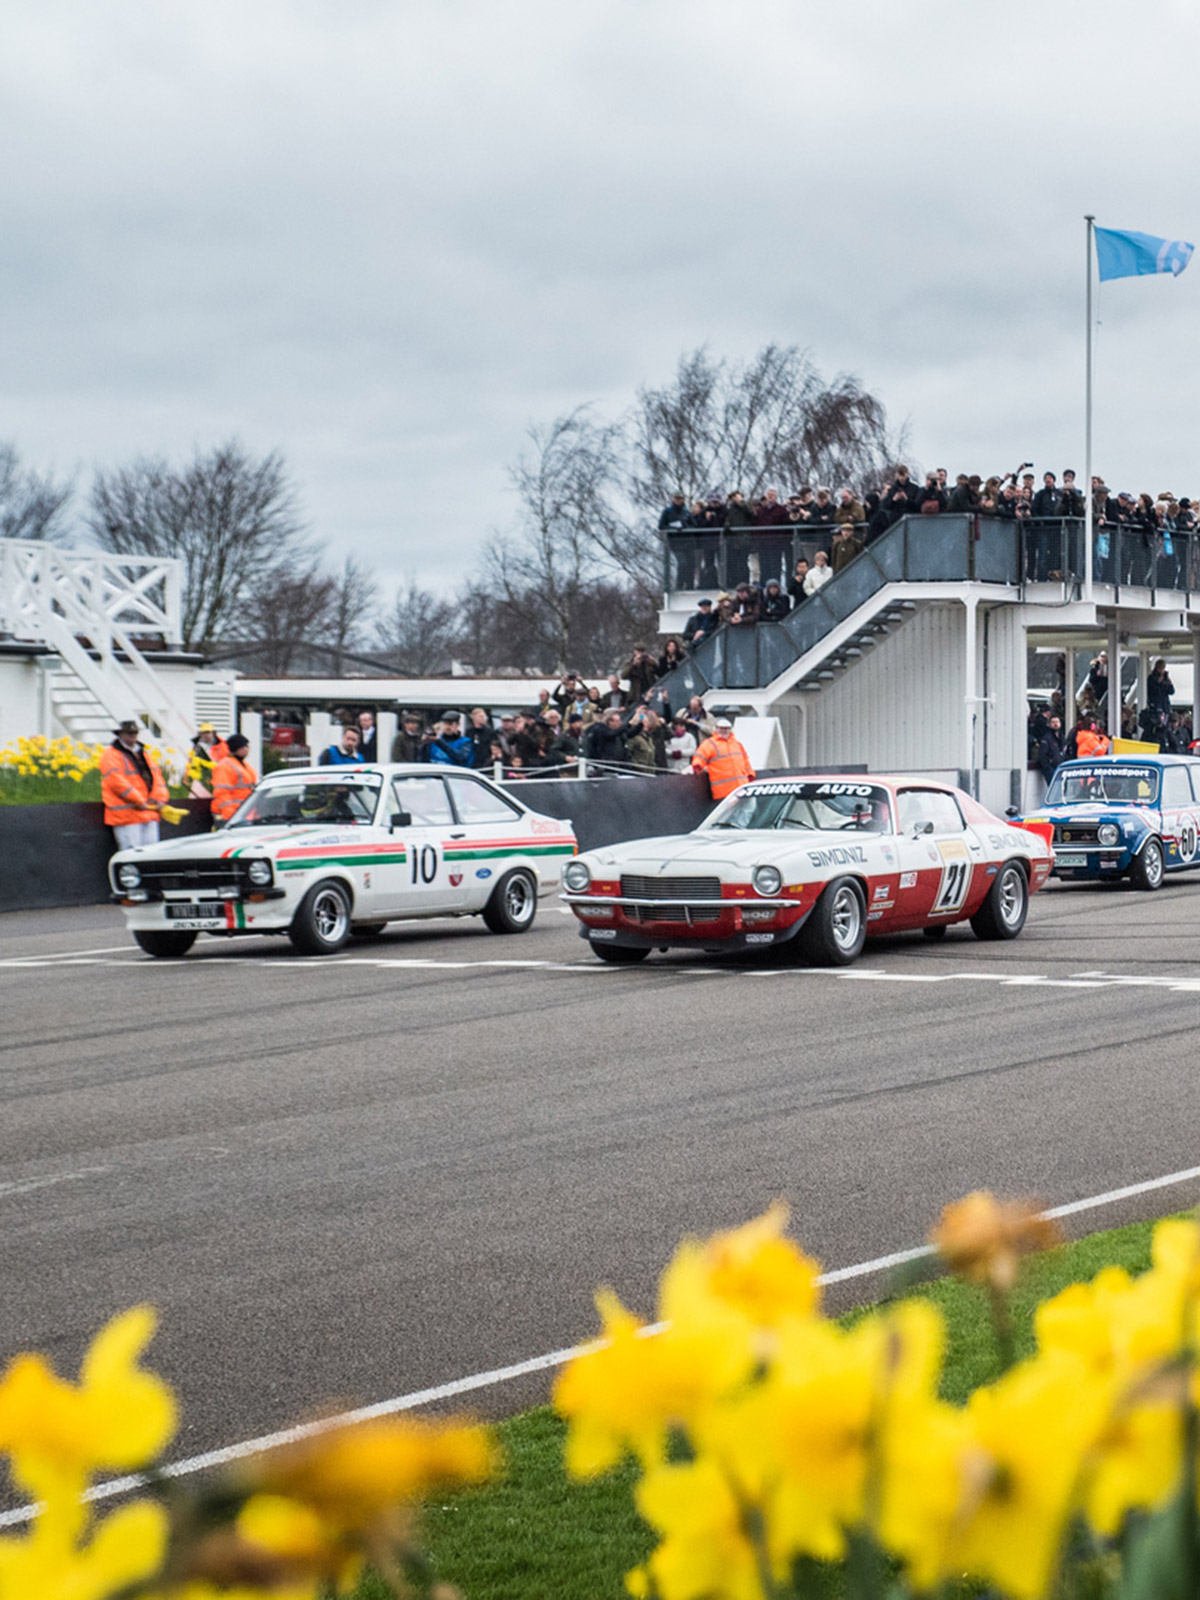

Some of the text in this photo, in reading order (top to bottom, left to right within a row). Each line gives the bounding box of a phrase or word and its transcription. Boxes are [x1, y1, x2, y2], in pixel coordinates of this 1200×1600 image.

[1179, 613, 1184, 627] 1
[746, 784, 873, 796] THINK AUTO
[1181, 827, 1195, 856] 60
[411, 844, 437, 884] 10
[807, 845, 868, 868] SIMONIZ
[938, 862, 967, 908] 21
